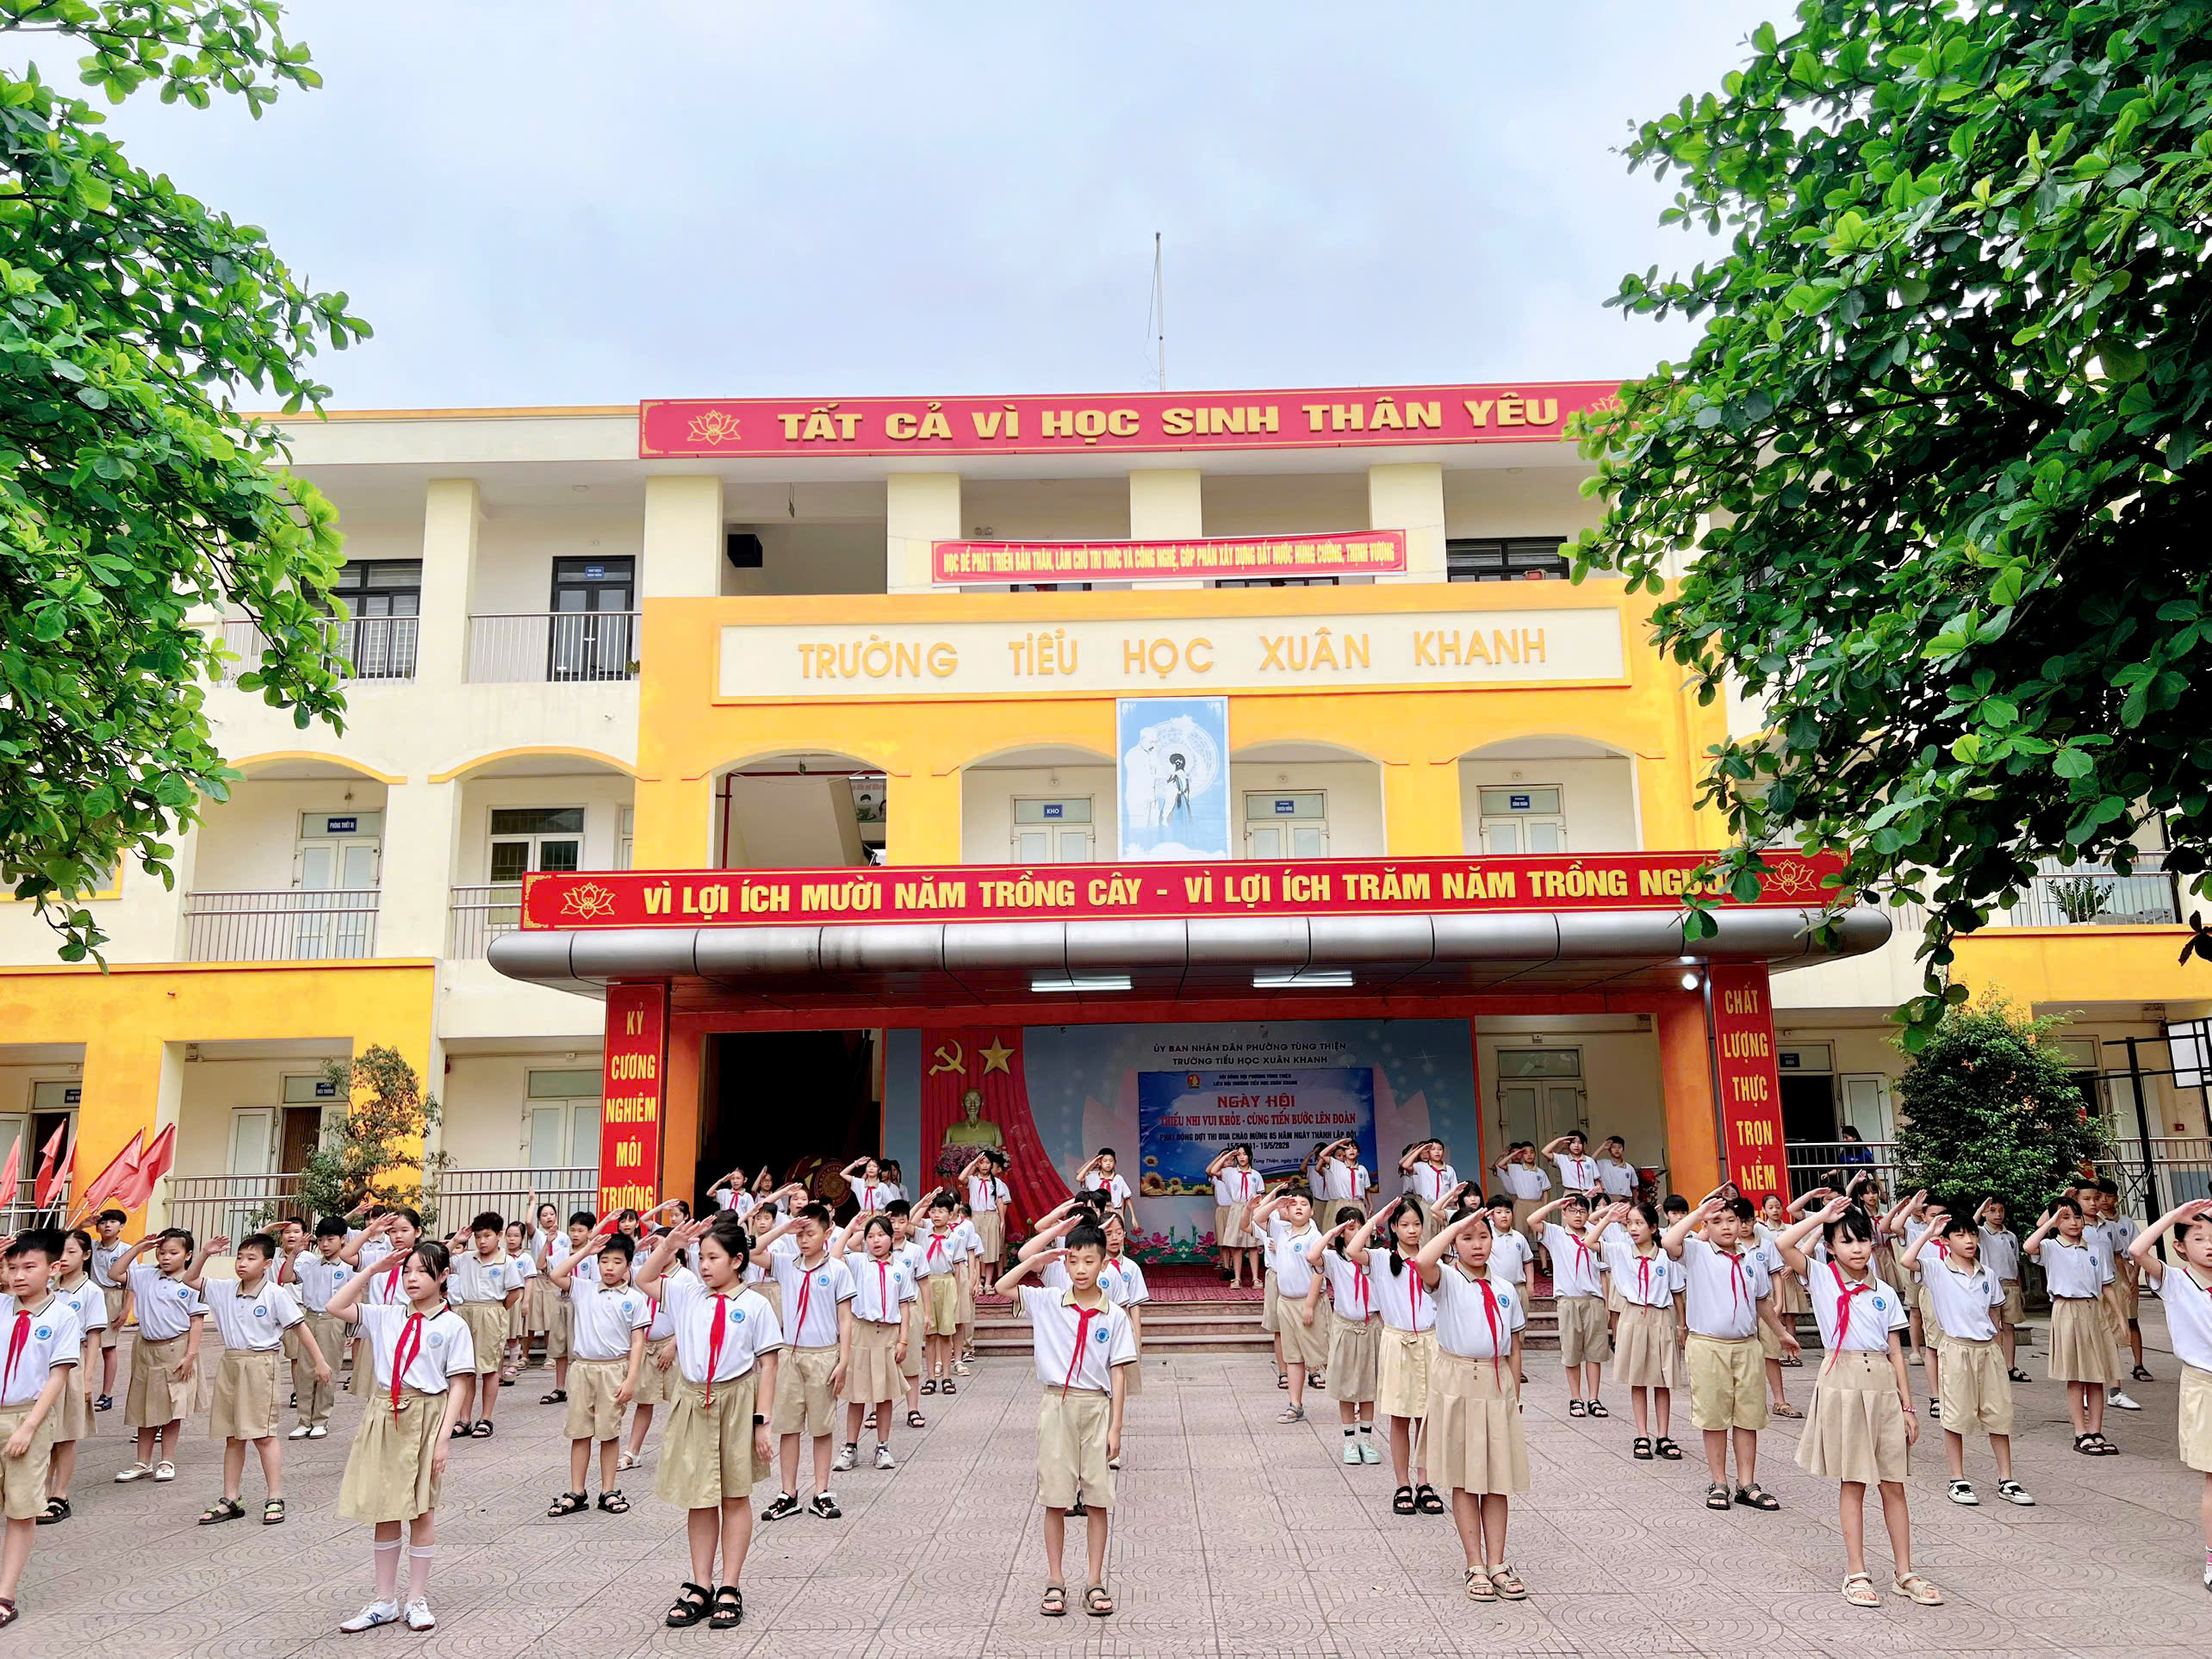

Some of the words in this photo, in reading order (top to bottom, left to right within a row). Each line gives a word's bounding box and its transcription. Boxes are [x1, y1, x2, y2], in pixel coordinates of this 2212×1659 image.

[778, 402, 863, 441] TẤT
[885, 401, 953, 441] CẢ
[971, 403, 1019, 440] VÌ
[1041, 407, 1140, 444] HỌC
[1161, 405, 1280, 436] SINH
[1302, 396, 1442, 432] THÂN
[1464, 391, 1558, 428] YÊU
[943, 553, 959, 576] HỌC
[972, 550, 991, 572] PHÁT
[992, 544, 1014, 571] TRIỂN
[1016, 545, 1032, 570] BẢN
[1033, 548, 1054, 572] THÂN,
[1055, 547, 1072, 570] LÀM
[1073, 544, 1088, 569] CHỦ
[1090, 550, 1102, 569] TRI
[1103, 546, 1122, 569] THỨC
[1123, 546, 1134, 568] VÀ
[1135, 545, 1155, 568] CÔNG
[1157, 544, 1178, 571] NGHỆ,
[1180, 544, 1196, 567] GÓP
[1196, 542, 1218, 566] PHẦN
[1219, 544, 1233, 566] XÂY
[1234, 545, 1256, 569] DỰNG
[1257, 539, 1271, 565] ĐẤT
[1272, 542, 1294, 564] NƯỚC
[1295, 542, 1315, 564] HÙNG
[1345, 544, 1368, 566] THỊNH
[1369, 541, 1395, 565] VƯỢNG
[798, 634, 958, 679] TRƯỜNG
[1009, 627, 1078, 676] TIỂU
[1122, 637, 1214, 680] HỌC
[1258, 626, 1370, 671] XUÂN
[1414, 627, 1547, 668] KHANH
[643, 880, 672, 915] VÌ
[682, 884, 729, 920] LỢI
[741, 879, 790, 913] ÍCH
[801, 874, 882, 912] MƯỜI
[895, 876, 966, 910] NĂM
[979, 870, 1076, 909] TRỒNG
[1088, 872, 1142, 907] CÂY
[1184, 871, 1213, 904] VÌ
[1224, 873, 1271, 909] LỢI
[1283, 868, 1331, 903] ÍCH
[1342, 867, 1431, 902] TRĂM
[1441, 865, 1516, 899] NĂM
[1526, 860, 1629, 898] TRỒNG
[1724, 981, 1758, 1015] CHẤT
[626, 1001, 644, 1035] KỶ
[1153, 1043, 1165, 1053] ỦY
[1191, 1043, 1220, 1052] NHÂN
[1222, 1042, 1243, 1052] DÂN
[1246, 1041, 1289, 1051] PHƯỜNG
[1290, 1041, 1317, 1051] TÙNG
[1319, 1041, 1346, 1052] THIỆN
[1172, 1056, 1213, 1066] TRƯỜNG
[1215, 1053, 1234, 1065] TIỂU
[1237, 1057, 1259, 1066] HỌC
[1263, 1054, 1290, 1064] XUÂN
[1723, 1030, 1769, 1063] LƯỢNG
[611, 1053, 656, 1080] CƯƠNG
[1217, 1092, 1260, 1108] NGÀY
[1266, 1092, 1296, 1109] HỘI
[1732, 1074, 1768, 1107] THỰC
[606, 1092, 656, 1123] NGHIÊM
[1160, 1111, 1184, 1127] THIẾU
[1186, 1115, 1201, 1126] NHI
[1202, 1115, 1217, 1126] VUI
[1219, 1111, 1241, 1126] KHỎE
[1247, 1112, 1269, 1125] CÙNG
[1271, 1109, 1290, 1125] TIẾN
[1292, 1111, 1314, 1124] BƯỚC
[1315, 1111, 1331, 1124] LÊN
[1333, 1110, 1356, 1124] ĐOÀN
[616, 1135, 642, 1167] MÔI
[1208, 1133, 1217, 1141] THI
[1232, 1131, 1248, 1140] CHÀO
[1278, 1130, 1292, 1140] NĂM
[1294, 1130, 1309, 1140] NGÀY
[1312, 1130, 1332, 1139] THÀNH
[1333, 1129, 1344, 1140] LẬP
[1737, 1120, 1774, 1151] TRỌN
[1741, 1155, 1778, 1190] NIỀM
[601, 1179, 655, 1213] TRƯỜNG
